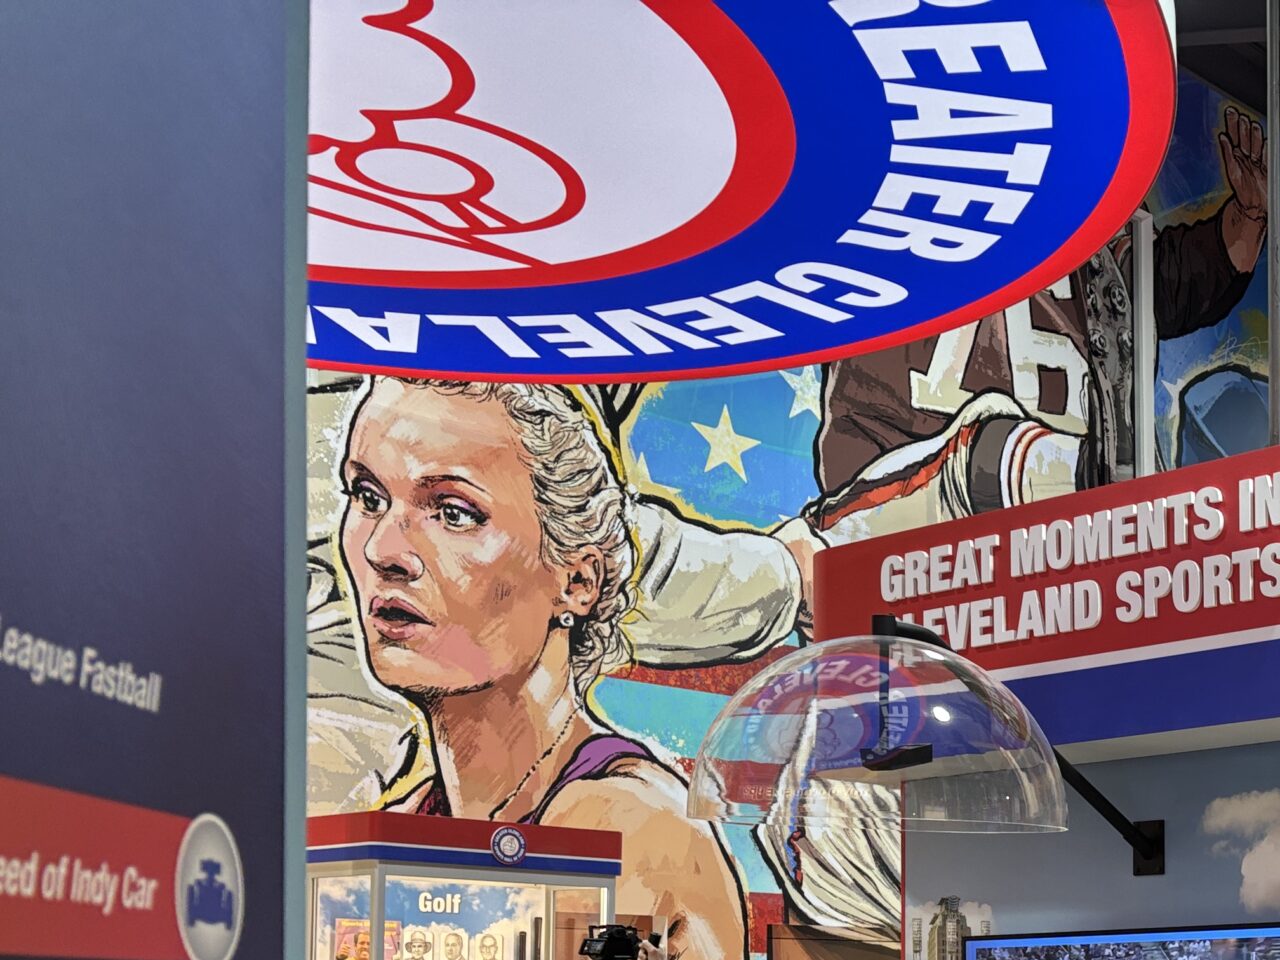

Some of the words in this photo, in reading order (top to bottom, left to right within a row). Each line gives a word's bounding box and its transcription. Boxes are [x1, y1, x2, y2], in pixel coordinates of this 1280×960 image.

[307, 262, 908, 359] CLEVELA
[879, 534, 1000, 603] GREAT
[1009, 486, 1225, 578] MOMENTS
[898, 579, 1102, 655] LEVELAND
[0, 618, 77, 687] eague
[79, 646, 163, 715] Fastball
[42, 856, 71, 901] of
[71, 858, 120, 916] Indy
[121, 866, 161, 910] Car
[418, 891, 462, 914] Golf
